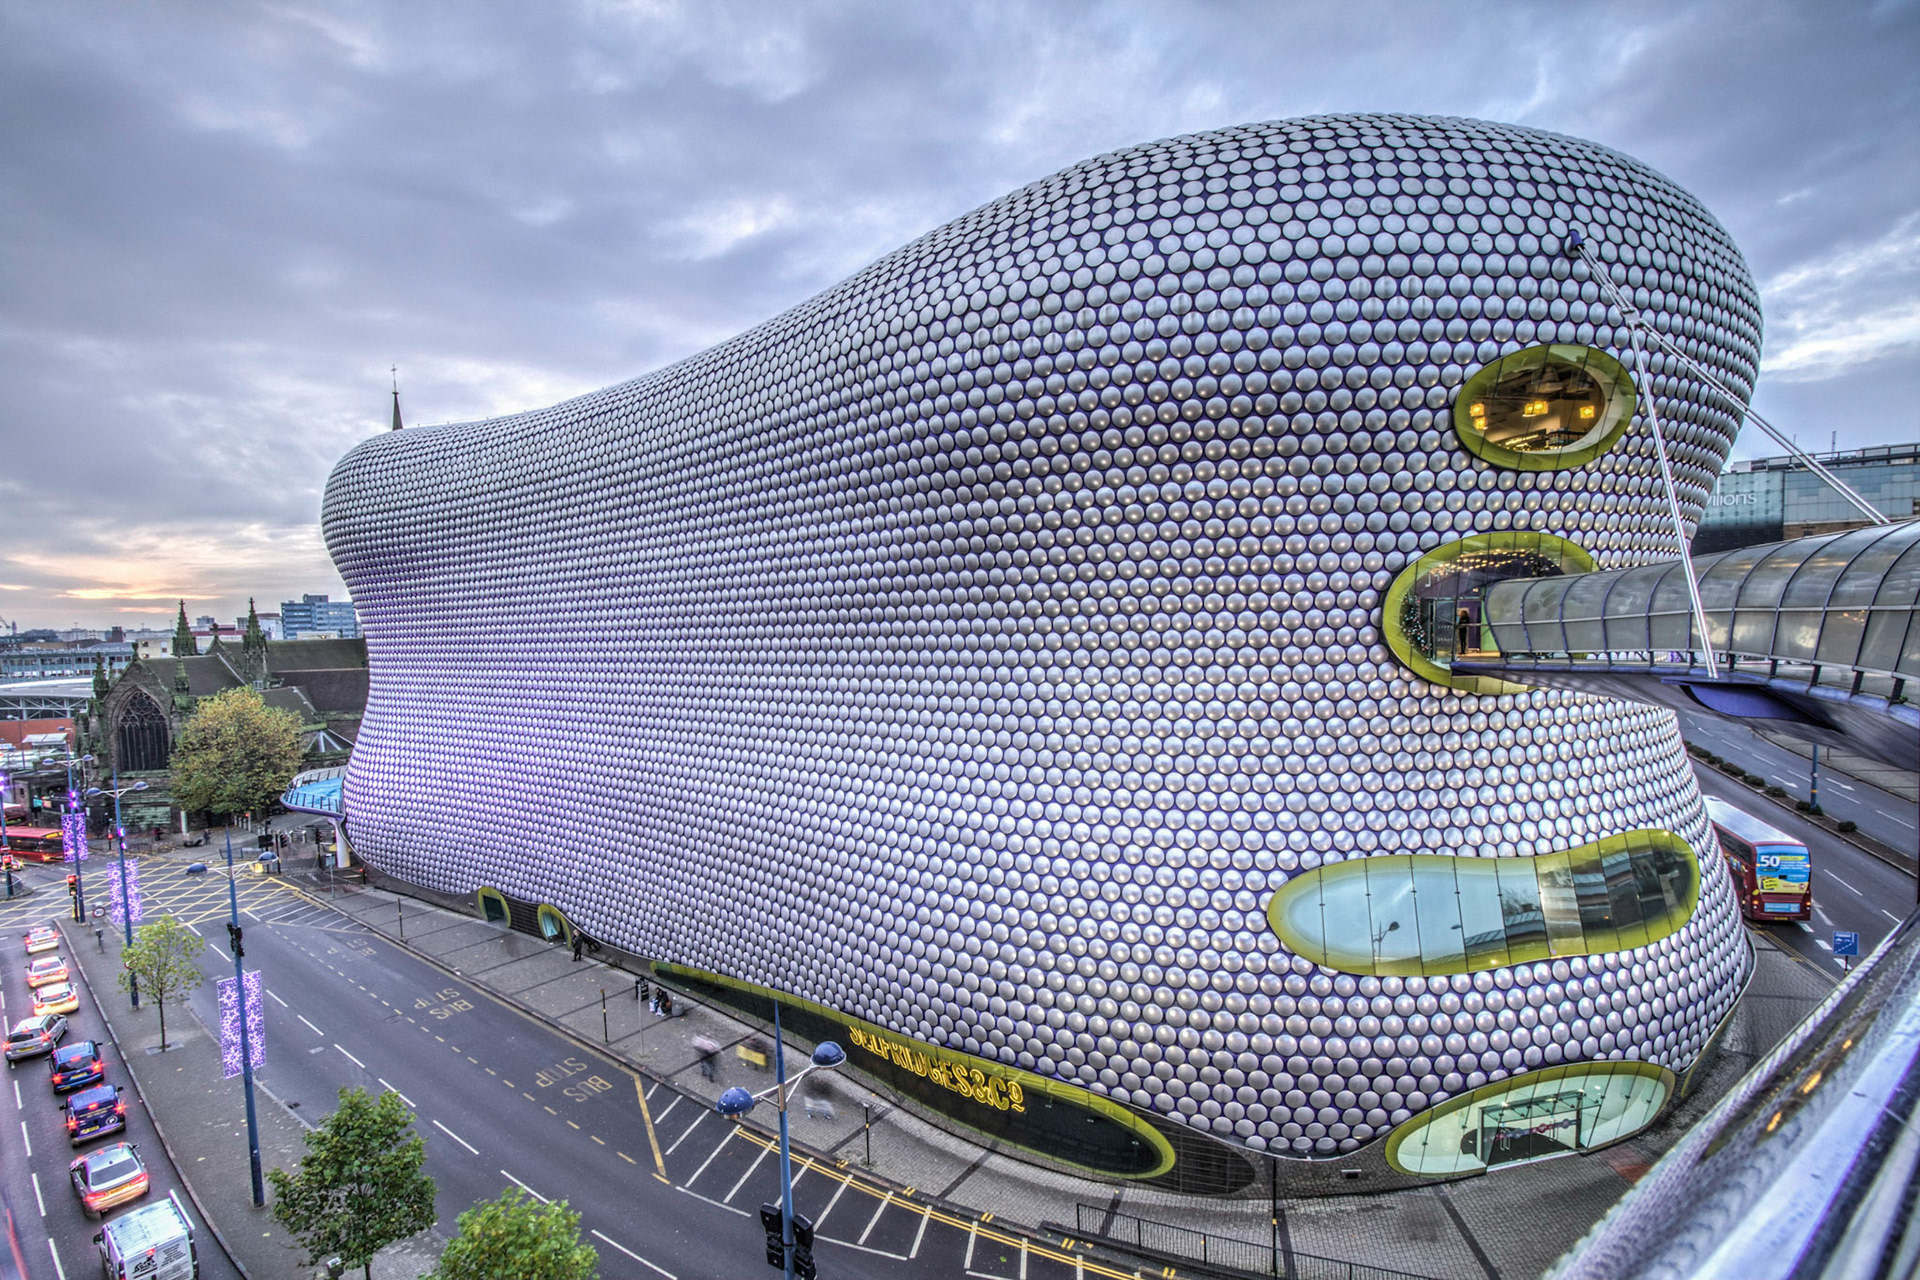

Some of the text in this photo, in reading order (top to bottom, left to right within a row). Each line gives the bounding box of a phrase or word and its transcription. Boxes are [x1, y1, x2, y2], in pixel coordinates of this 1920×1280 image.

[1760, 855, 1780, 867] 50
[429, 999, 474, 1020] BUS
[535, 1057, 588, 1088] STOP
[563, 1075, 613, 1103] BUS
